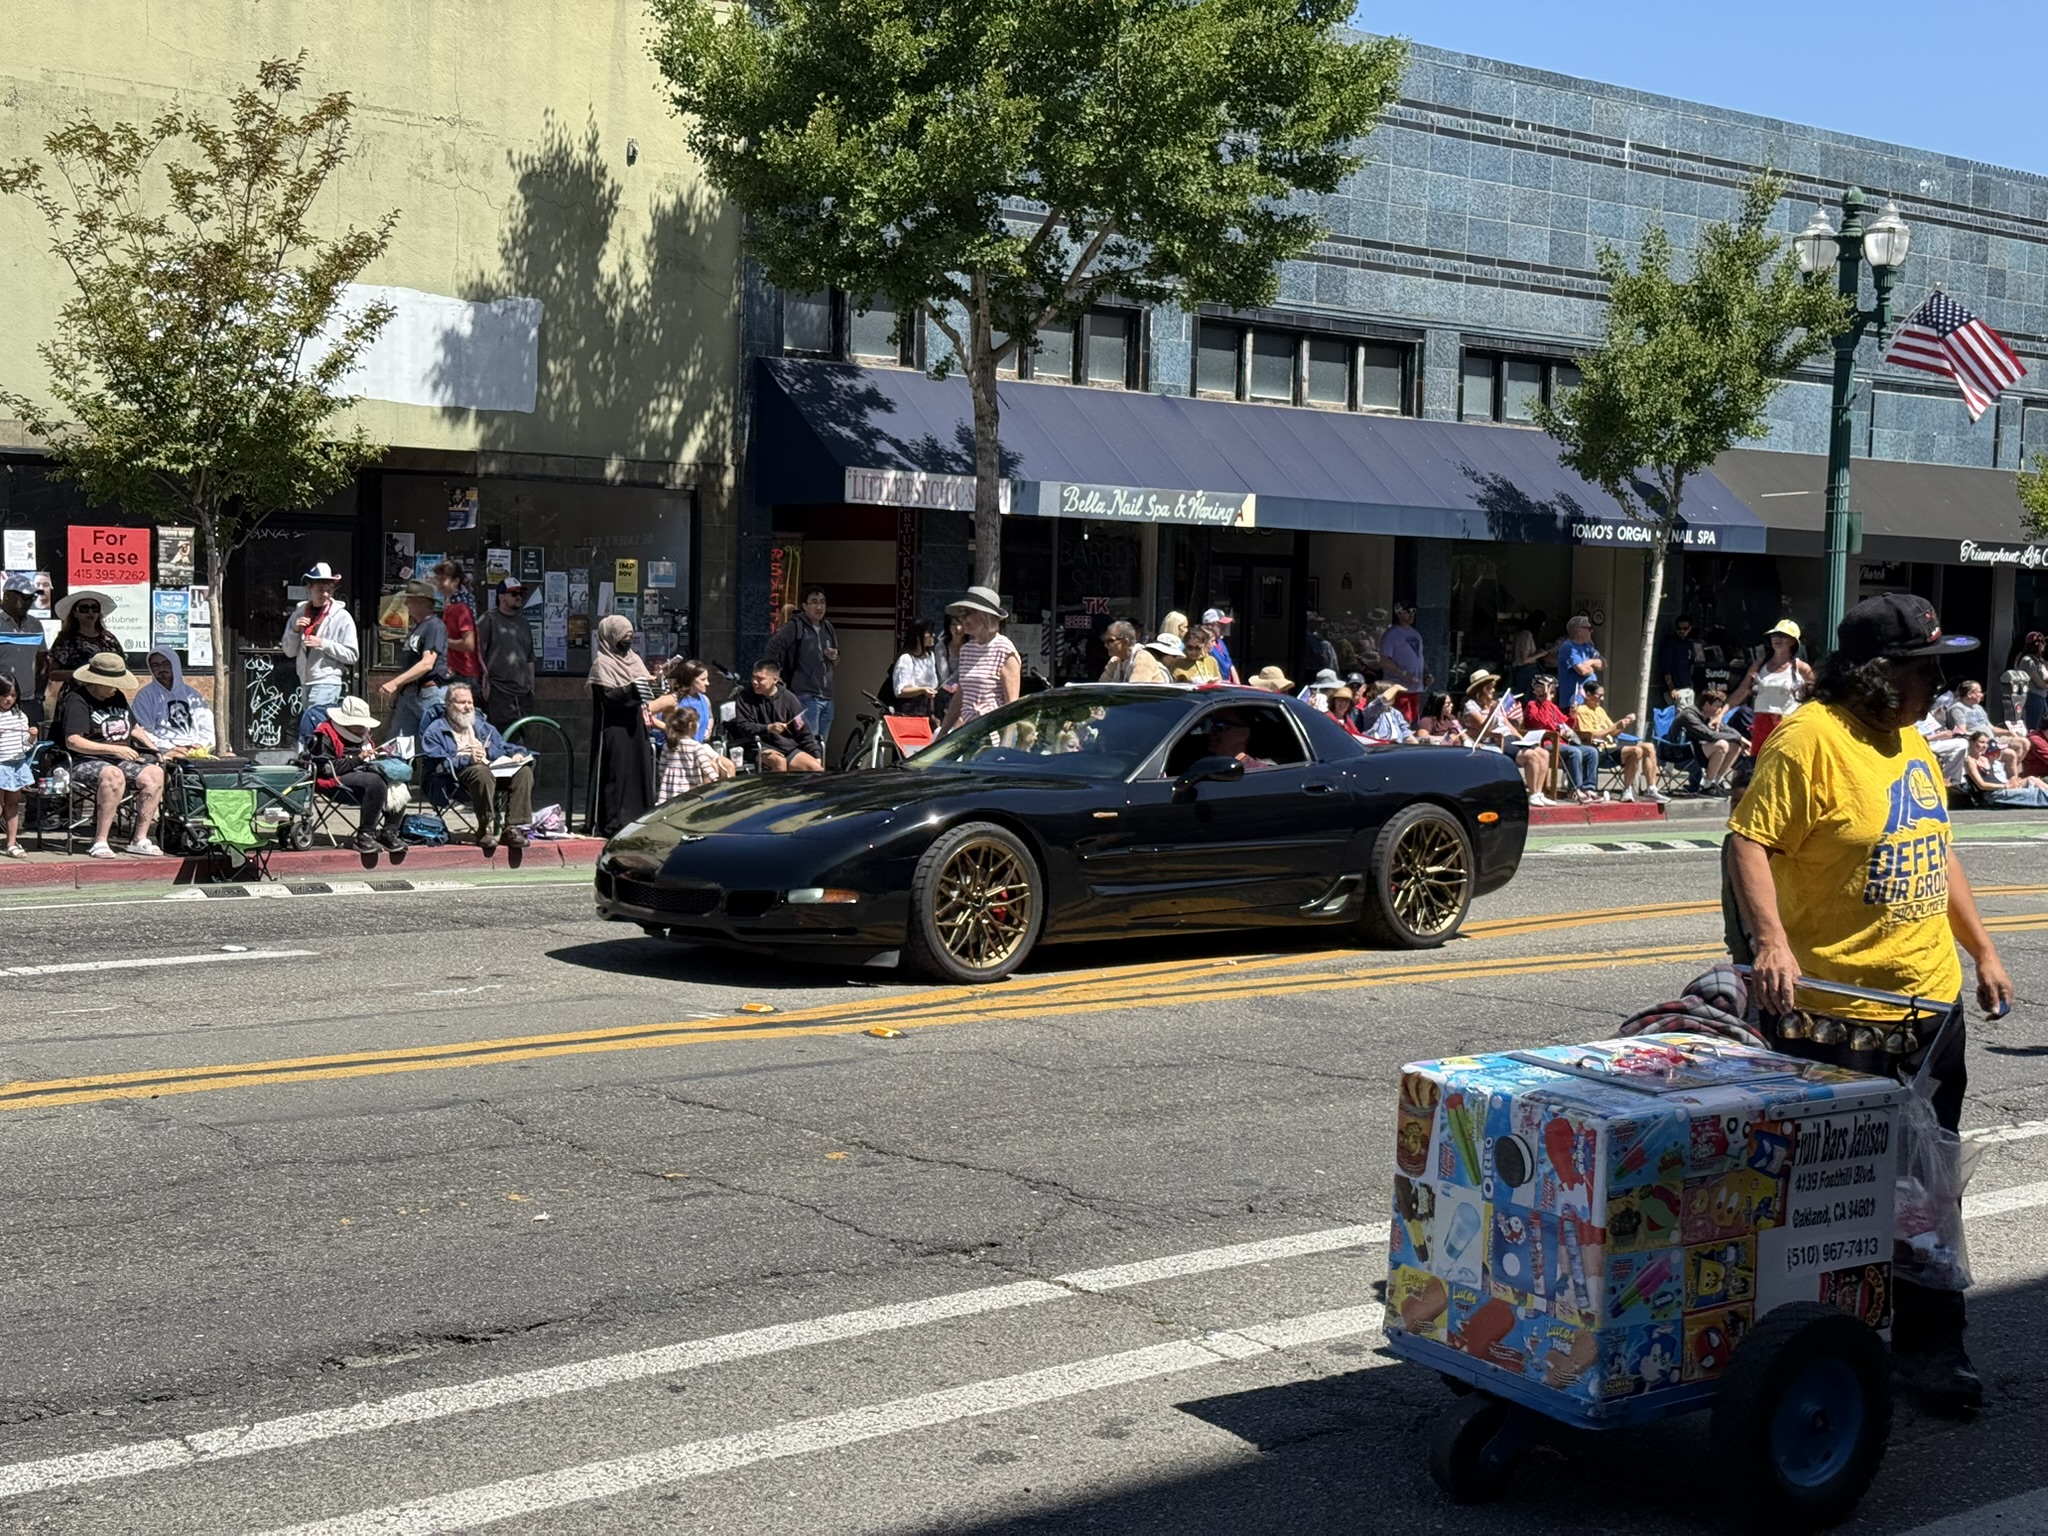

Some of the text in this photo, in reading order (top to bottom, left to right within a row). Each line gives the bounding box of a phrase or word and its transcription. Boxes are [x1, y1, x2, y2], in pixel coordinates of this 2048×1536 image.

[852, 475, 902, 503] LITTLE
[1063, 486, 1235, 526] Bella Nail Spa & Waxing
[93, 530, 126, 545] For
[1572, 524, 1613, 539] TOMO'S
[1671, 529, 1693, 543] NAIL
[1698, 530, 1716, 545] SPA
[81, 548, 138, 565] Lease
[619, 562, 635, 570] IMP
[1960, 540, 2020, 566] Triumphant
[2020, 545, 2041, 568] Life
[73, 569, 146, 580] 415.395.7262
[1082, 597, 1110, 615] TK
[135, 641, 147, 650] JLL
[1705, 668, 1730, 680] Sunday
[1863, 879, 1910, 904] OUR
[1821, 1119, 1849, 1162] Bars
[1849, 1113, 1889, 1159] Jalisco
[1482, 1136, 1494, 1200] OREO
[1795, 1172, 1819, 1193] 4139
[1819, 1167, 1853, 1190] Foothill
[1793, 1203, 1831, 1228] Oakland,
[1834, 1202, 1846, 1221] CA
[1787, 1237, 1878, 1272] (510) 967-7413
